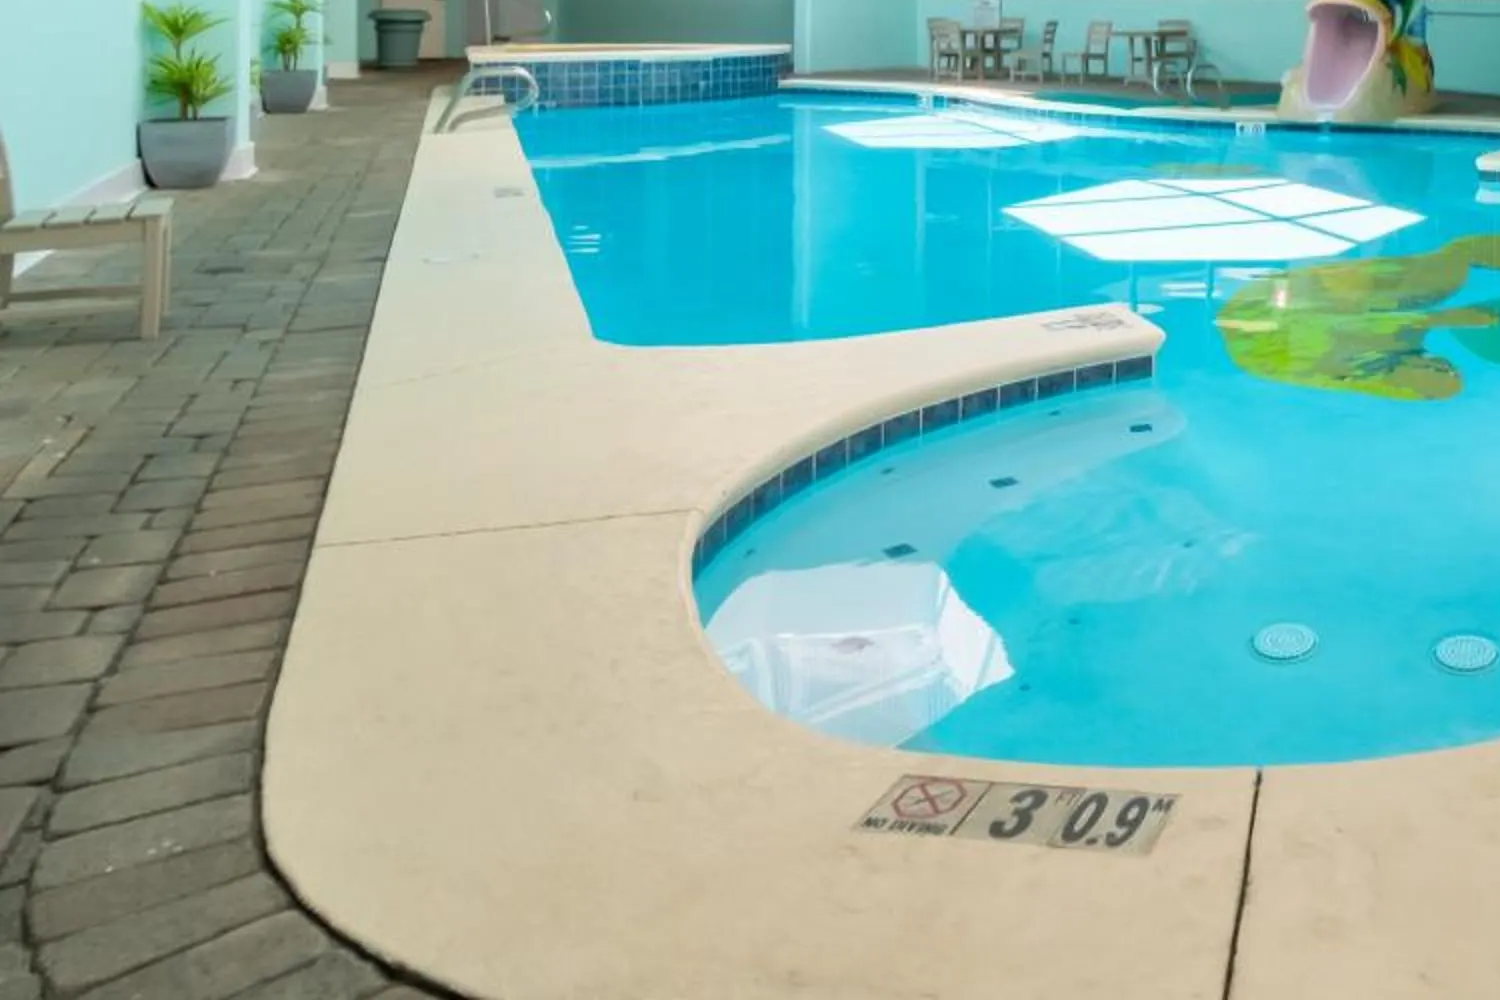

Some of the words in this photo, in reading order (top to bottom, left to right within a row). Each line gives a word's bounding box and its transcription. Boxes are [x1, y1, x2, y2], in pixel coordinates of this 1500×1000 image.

[862, 817, 889, 830] NO
[988, 789, 1048, 839] 3
[1061, 791, 1149, 847] 0.9
[1151, 798, 1175, 812] M
